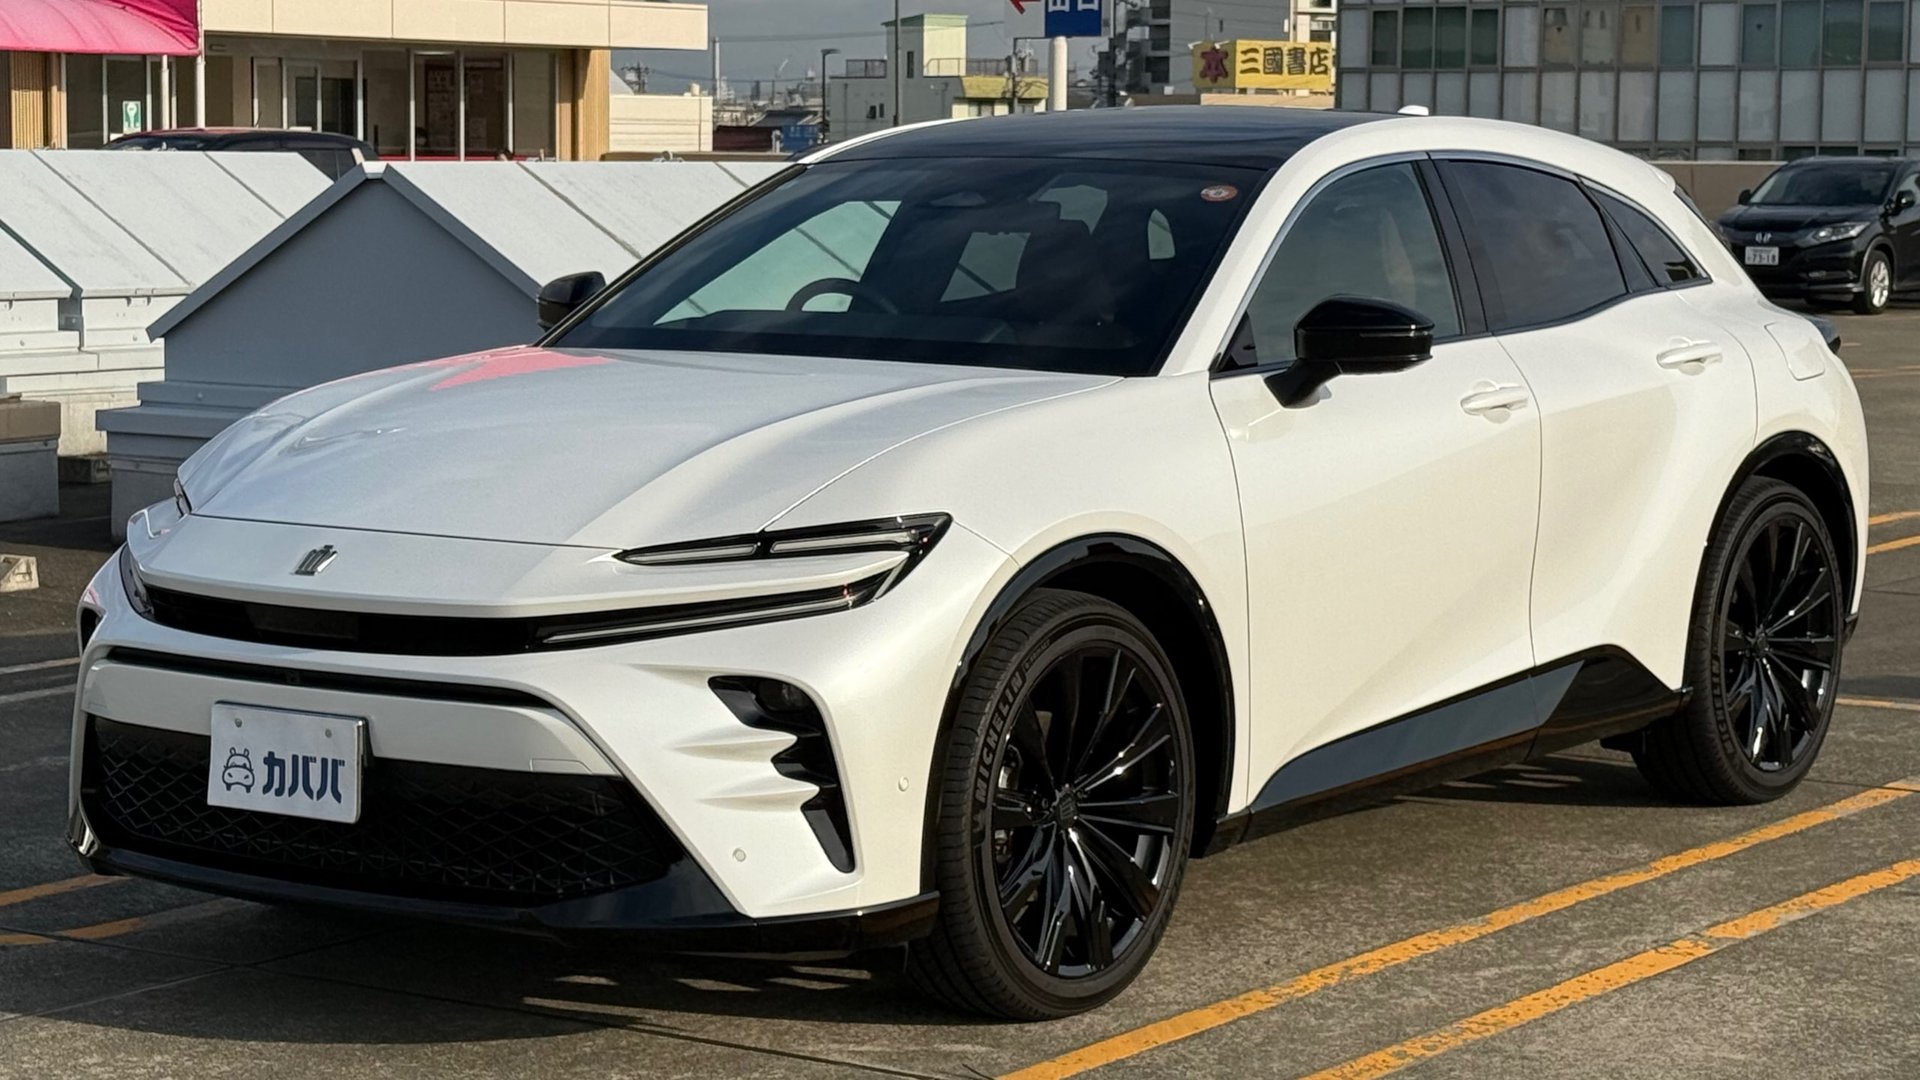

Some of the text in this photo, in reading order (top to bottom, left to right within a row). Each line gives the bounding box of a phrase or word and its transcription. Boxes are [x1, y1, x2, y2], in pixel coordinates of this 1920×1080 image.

[1239, 46, 1329, 75] 三國書店
[973, 670, 1023, 804] MICHELIN
[262, 751, 346, 804] カババ
